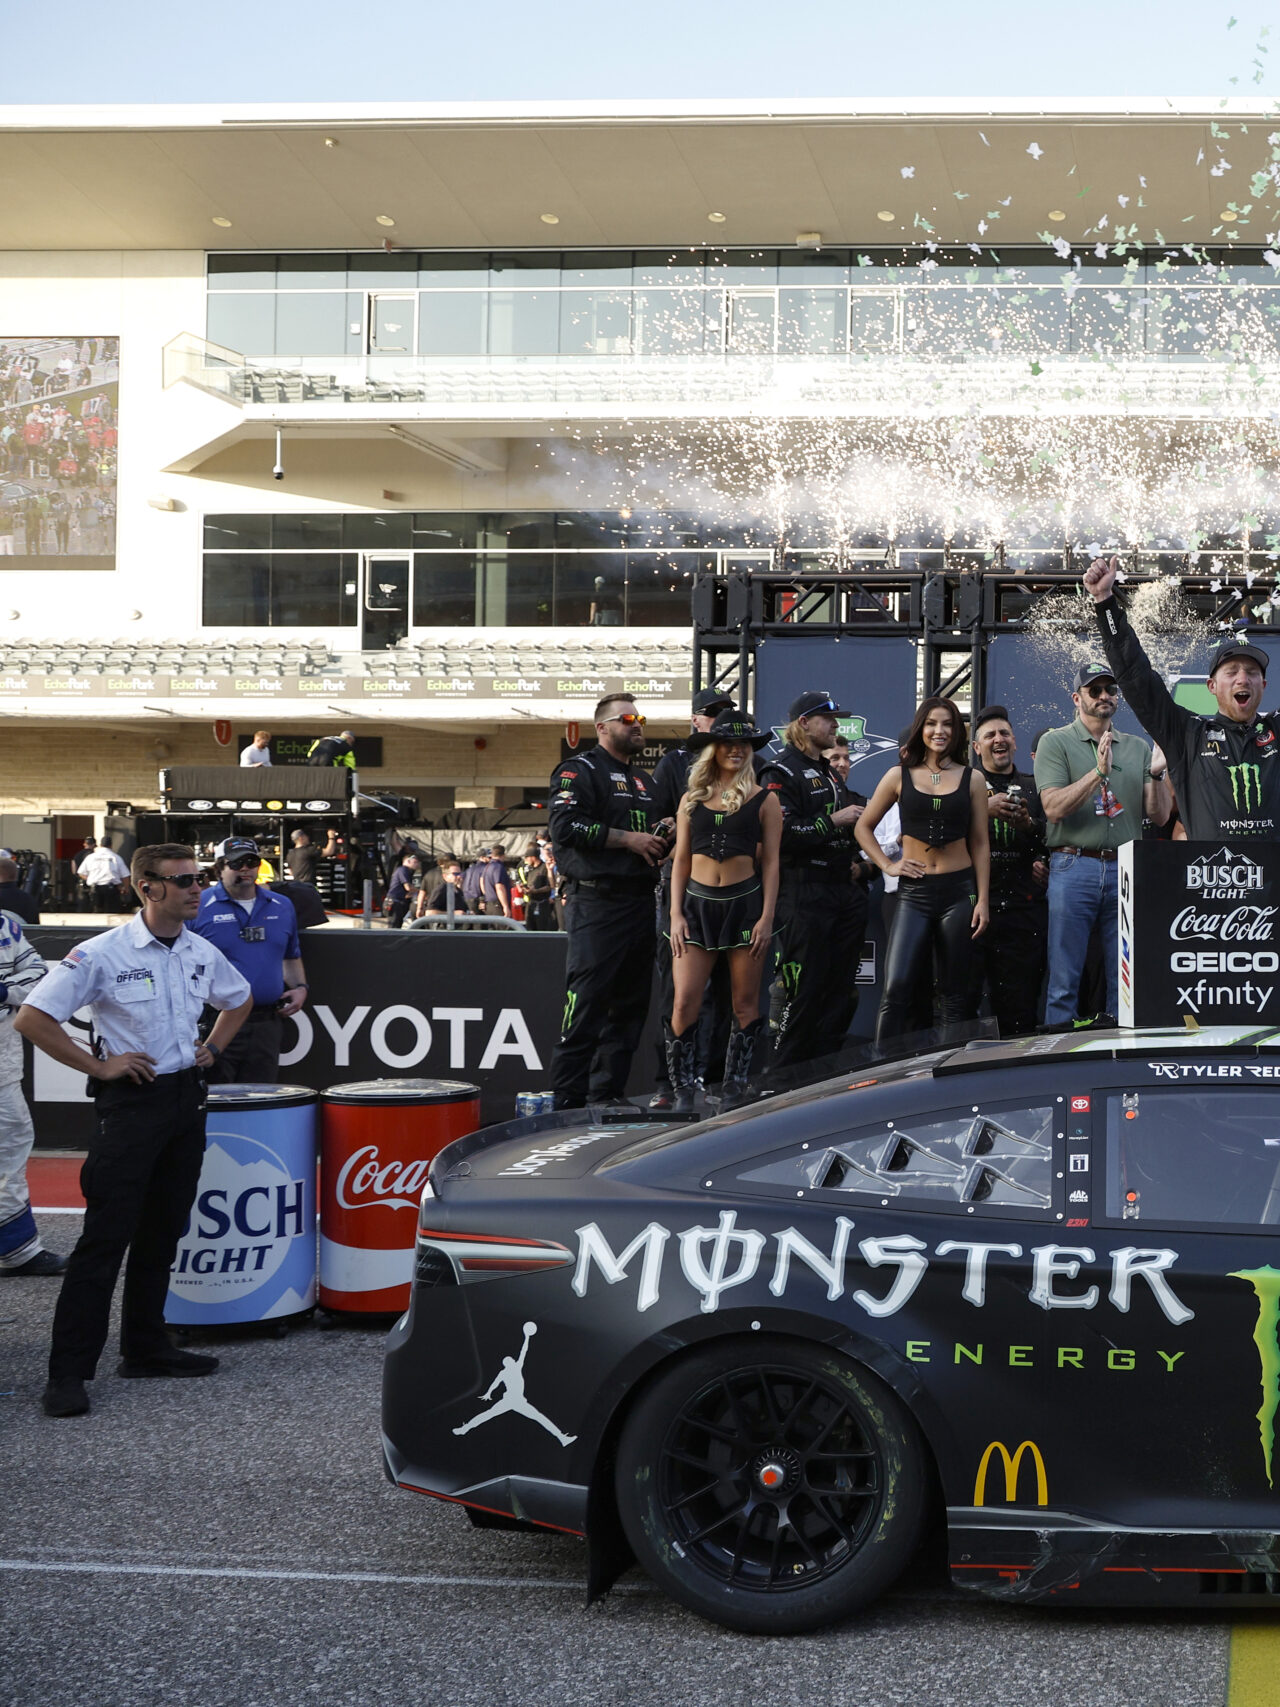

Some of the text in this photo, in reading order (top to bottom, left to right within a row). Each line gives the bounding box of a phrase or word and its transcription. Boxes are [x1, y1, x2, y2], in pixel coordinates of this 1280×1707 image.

[171, 679, 218, 690] EchoPark
[235, 679, 282, 691] EchoPark
[298, 679, 346, 691] EchoPark
[363, 679, 411, 691] EchoPark
[427, 679, 475, 691] EchoPark
[493, 679, 541, 692] EchoPark
[557, 679, 606, 692] EchoPark
[623, 679, 672, 692] EchoPark
[1220, 819, 1274, 830] MONSTER
[1185, 864, 1264, 890] BUSCH
[1202, 888, 1247, 899] LIGHT
[1169, 905, 1279, 941] Coca-Cola
[1170, 951, 1280, 973] GEICO
[116, 970, 154, 983] OFFICIAL
[1176, 979, 1274, 1013] xfinity
[1179, 1065, 1243, 1077] TYLER
[571, 1210, 1195, 1325] MONSTER
[906, 1340, 1186, 1372] ENERGY
